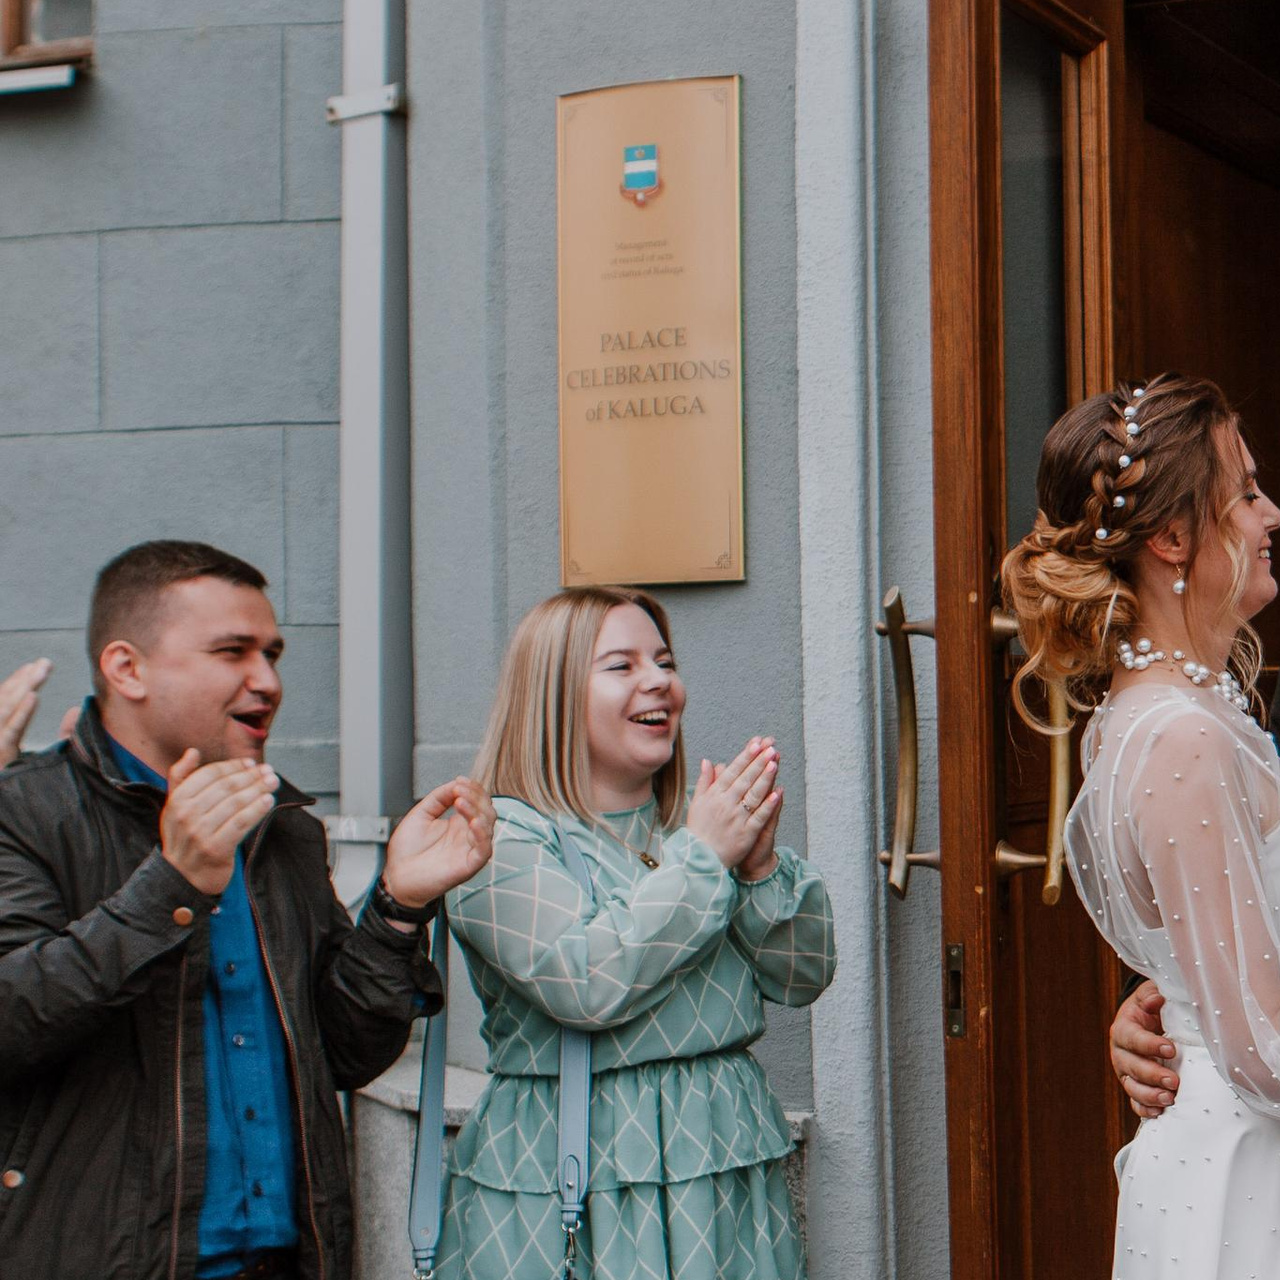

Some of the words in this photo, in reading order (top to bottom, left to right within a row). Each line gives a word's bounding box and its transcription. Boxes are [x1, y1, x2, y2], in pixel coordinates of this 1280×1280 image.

[600, 327, 687, 353] PALACE
[566, 359, 731, 390] CELEBRATIONS
[585, 402, 603, 421] of
[607, 395, 706, 420] KALUGA
